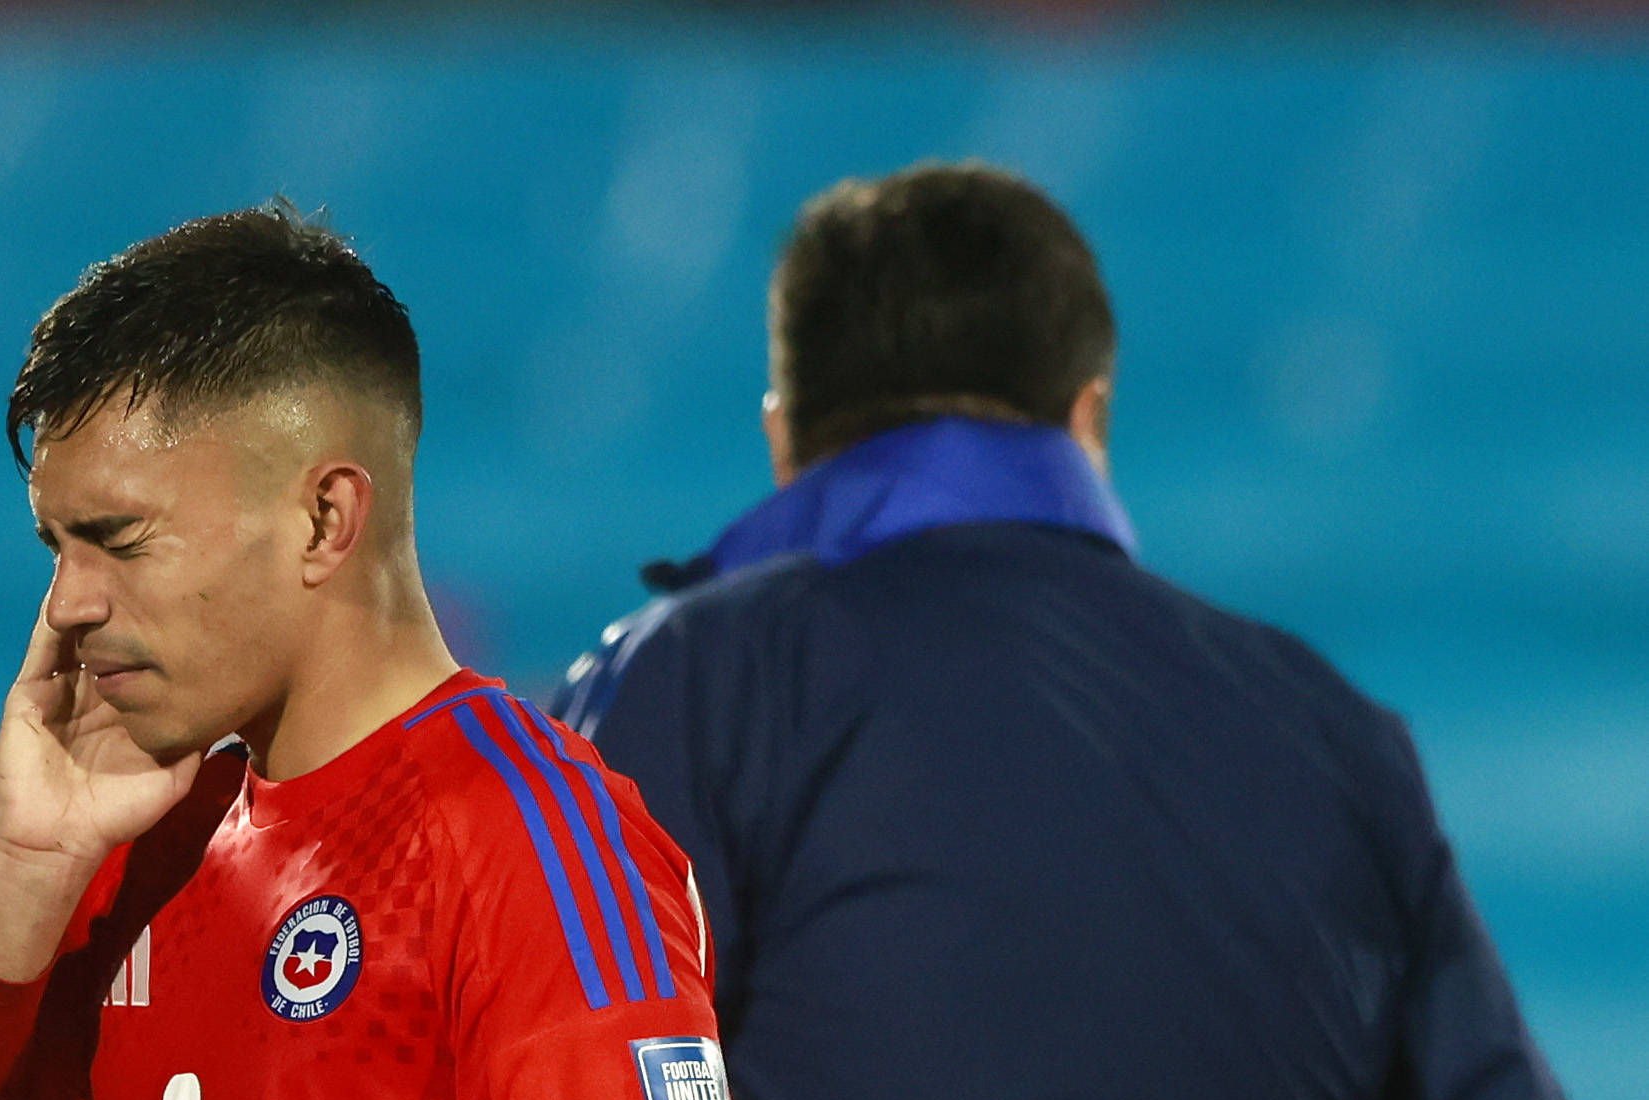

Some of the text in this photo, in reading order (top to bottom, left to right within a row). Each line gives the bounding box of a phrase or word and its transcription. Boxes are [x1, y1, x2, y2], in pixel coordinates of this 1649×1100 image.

[269, 899, 360, 965] FEDERACION DE FUTBOL
[271, 995, 325, 1018] DE CHILE
